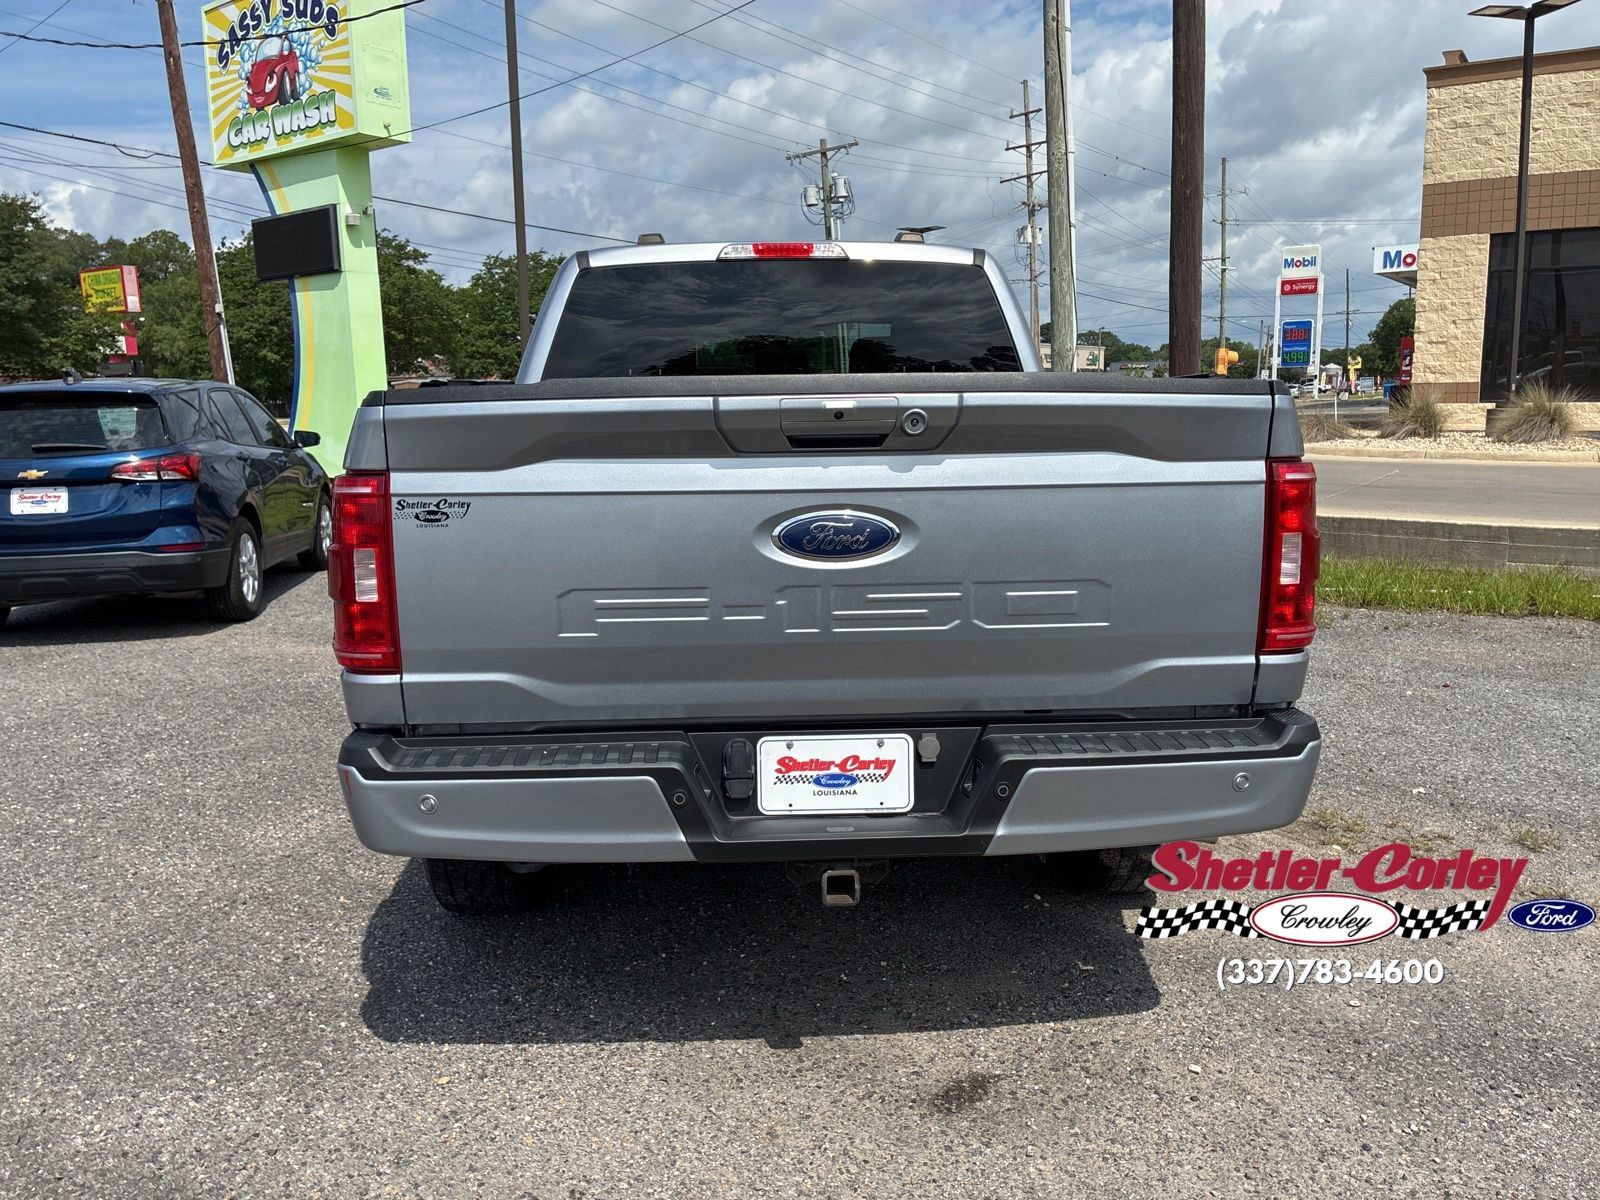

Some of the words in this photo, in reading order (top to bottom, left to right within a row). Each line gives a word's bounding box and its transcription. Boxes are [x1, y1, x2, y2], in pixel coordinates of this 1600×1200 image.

[217, 0, 272, 71] SASSY
[281, 0, 340, 39] SUDS
[228, 110, 271, 148] CAR
[271, 89, 337, 138] WASH
[1283, 256, 1317, 269] Mobil
[1292, 283, 1316, 292] Synergy
[395, 498, 472, 519] Shetler-Corley
[803, 521, 871, 550] Ford
[556, 579, 1111, 638] F-150
[774, 754, 897, 782] Shetler-Corley
[818, 774, 852, 786] Crowley
[812, 789, 858, 797] LOUISIANA
